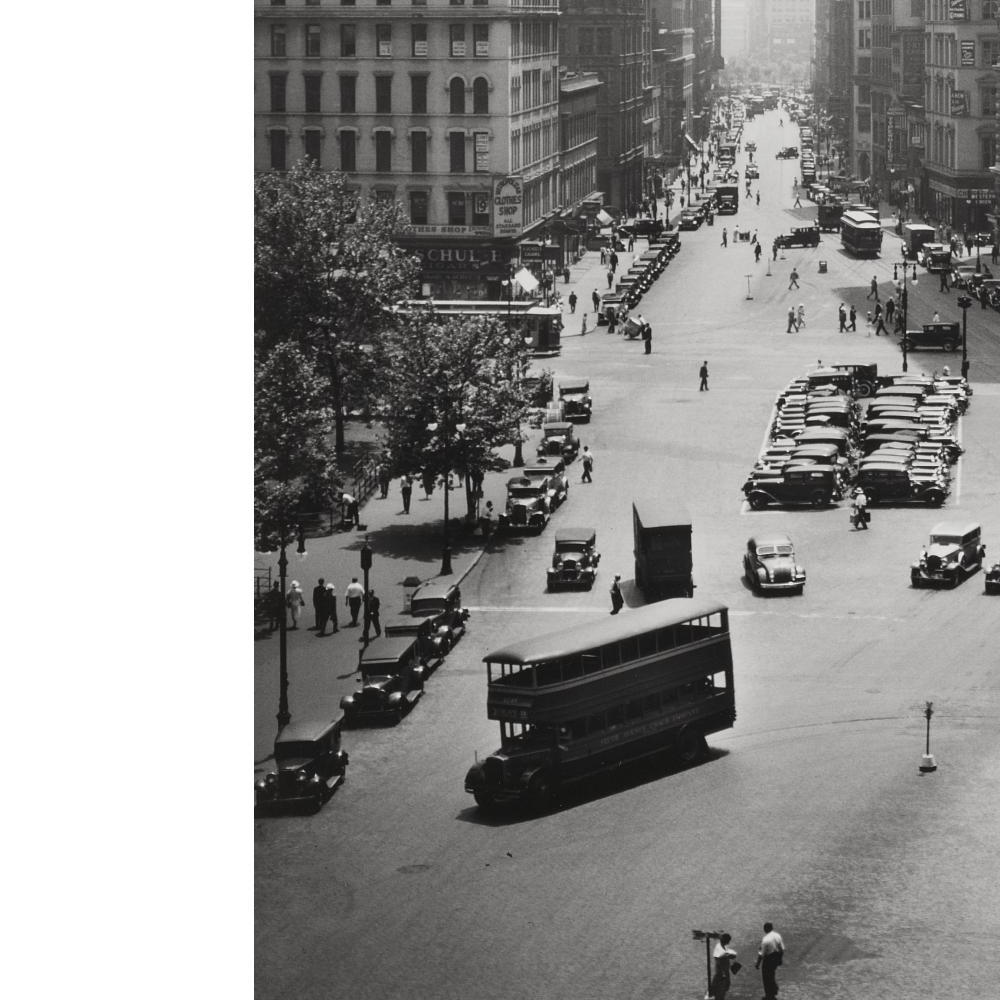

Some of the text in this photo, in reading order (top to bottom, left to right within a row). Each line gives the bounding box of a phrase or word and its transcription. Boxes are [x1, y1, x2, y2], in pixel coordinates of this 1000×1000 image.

[495, 195, 521, 205] CLOTHES
[498, 206, 517, 216] SHOP
[415, 249, 502, 262] SCHULE
